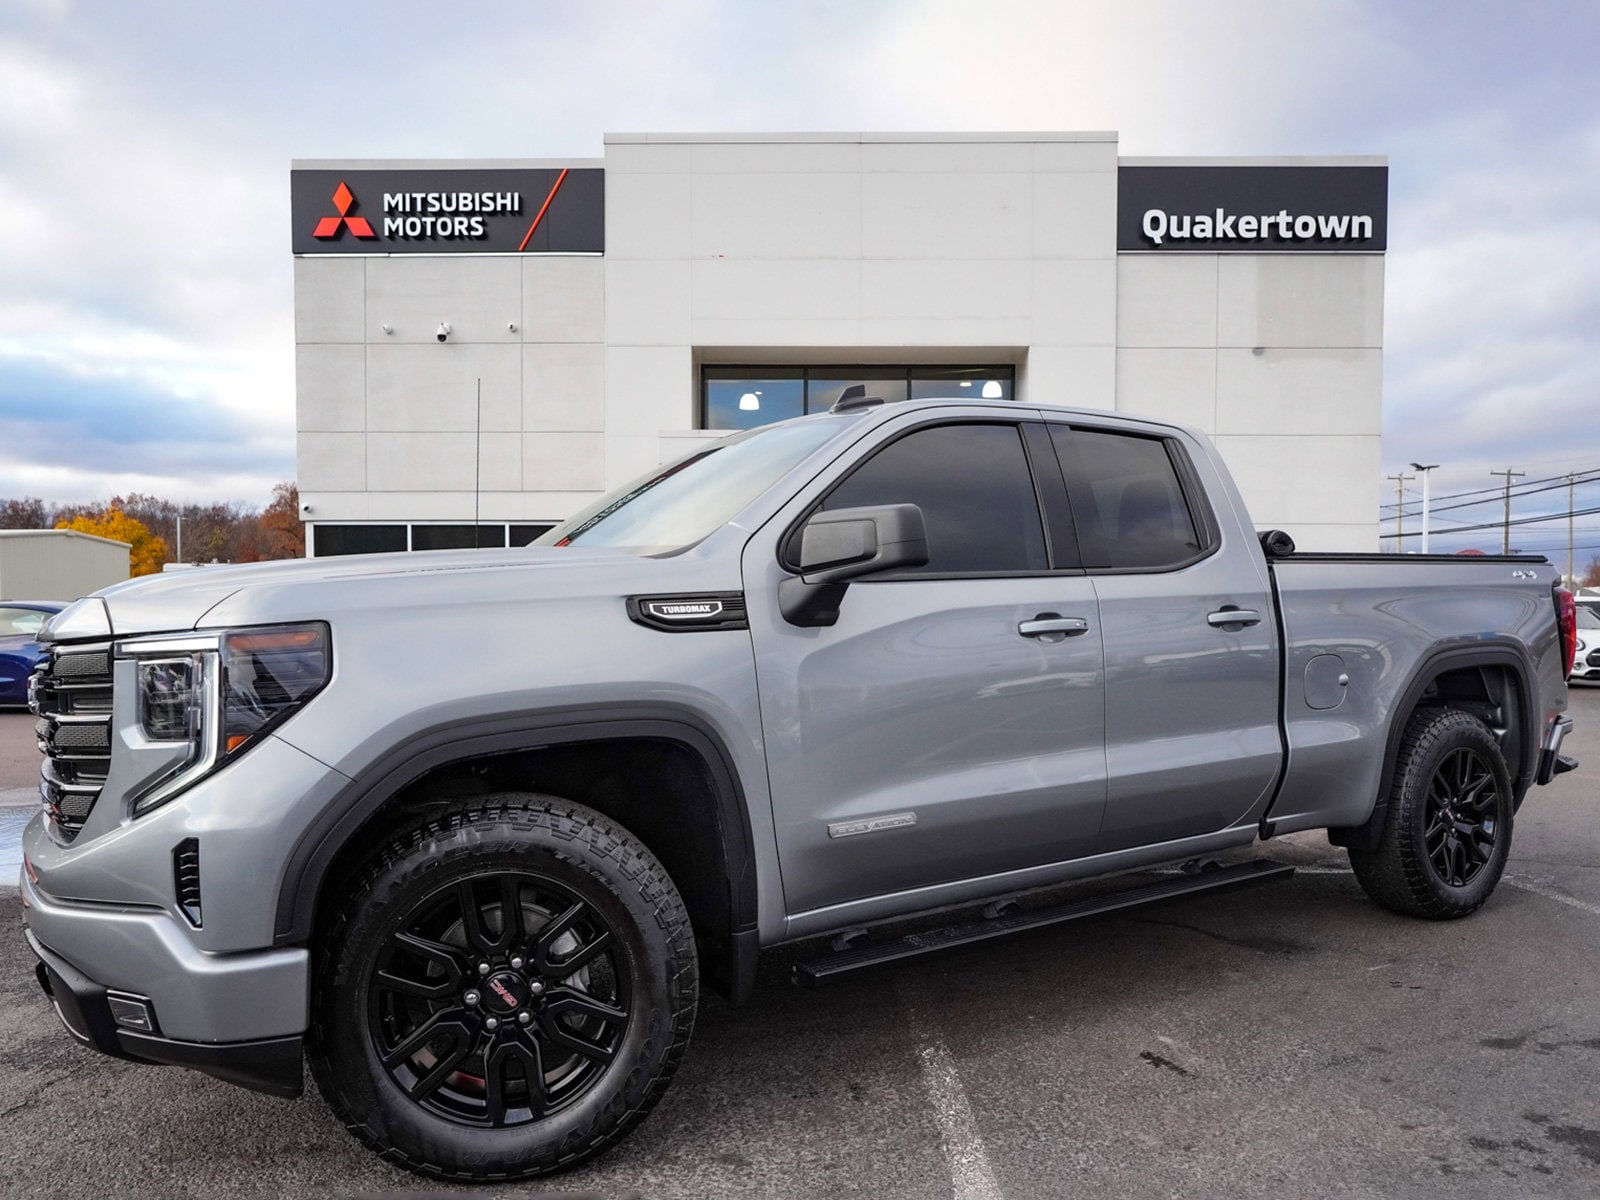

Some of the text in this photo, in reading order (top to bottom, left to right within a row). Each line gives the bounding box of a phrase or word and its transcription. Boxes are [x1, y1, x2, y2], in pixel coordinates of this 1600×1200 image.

[383, 192, 520, 212] MITSUBISHI
[383, 217, 484, 237] MOTORS
[1142, 208, 1373, 244] Quakertown
[661, 604, 712, 614] TURBOMAX
[489, 979, 518, 1007] GMC
